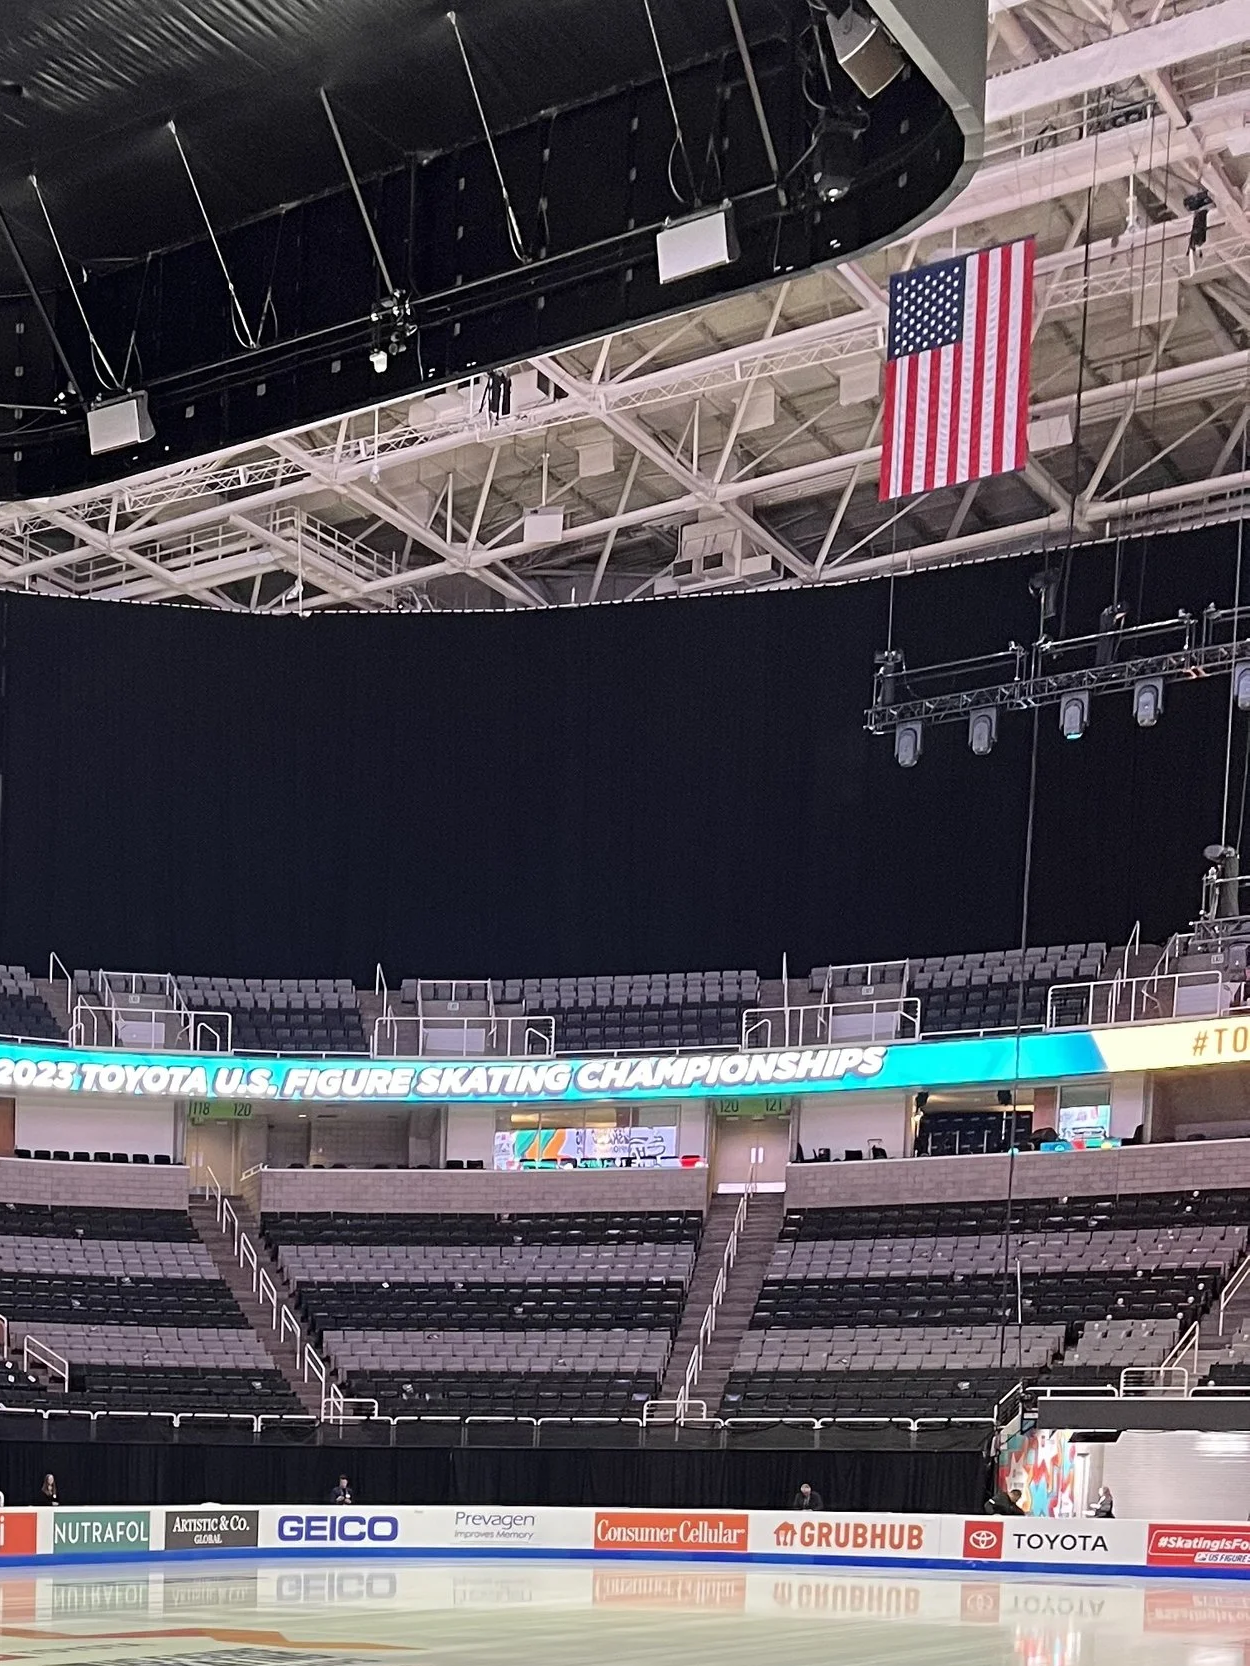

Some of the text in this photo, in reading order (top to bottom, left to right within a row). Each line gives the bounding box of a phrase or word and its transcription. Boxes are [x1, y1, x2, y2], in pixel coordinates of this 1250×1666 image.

[80, 1063, 208, 1094] TOYOTA
[214, 1067, 278, 1096] U.S.
[283, 1066, 416, 1098] FIGURE
[416, 1063, 572, 1096] SKATING
[576, 1045, 886, 1090] CHAMPIONSHIPS
[194, 1101, 210, 1116] 118
[233, 1102, 252, 1117] 120
[720, 1099, 739, 1113] 120
[765, 1098, 782, 1112] 121
[172, 1515, 219, 1533] ARTISTIC
[277, 1515, 399, 1542] GEICO
[455, 1511, 535, 1530] Prevagen
[54, 1520, 149, 1545] NUTRAFOL
[194, 1533, 223, 1545] GLOBAL
[454, 1530, 534, 1541] Improves Memory
[597, 1519, 677, 1544] Consumer
[800, 1521, 924, 1551] GRUBHUB
[1012, 1533, 1109, 1552] TOYOTA
[1158, 1536, 1250, 1551] #SkatingIsFo
